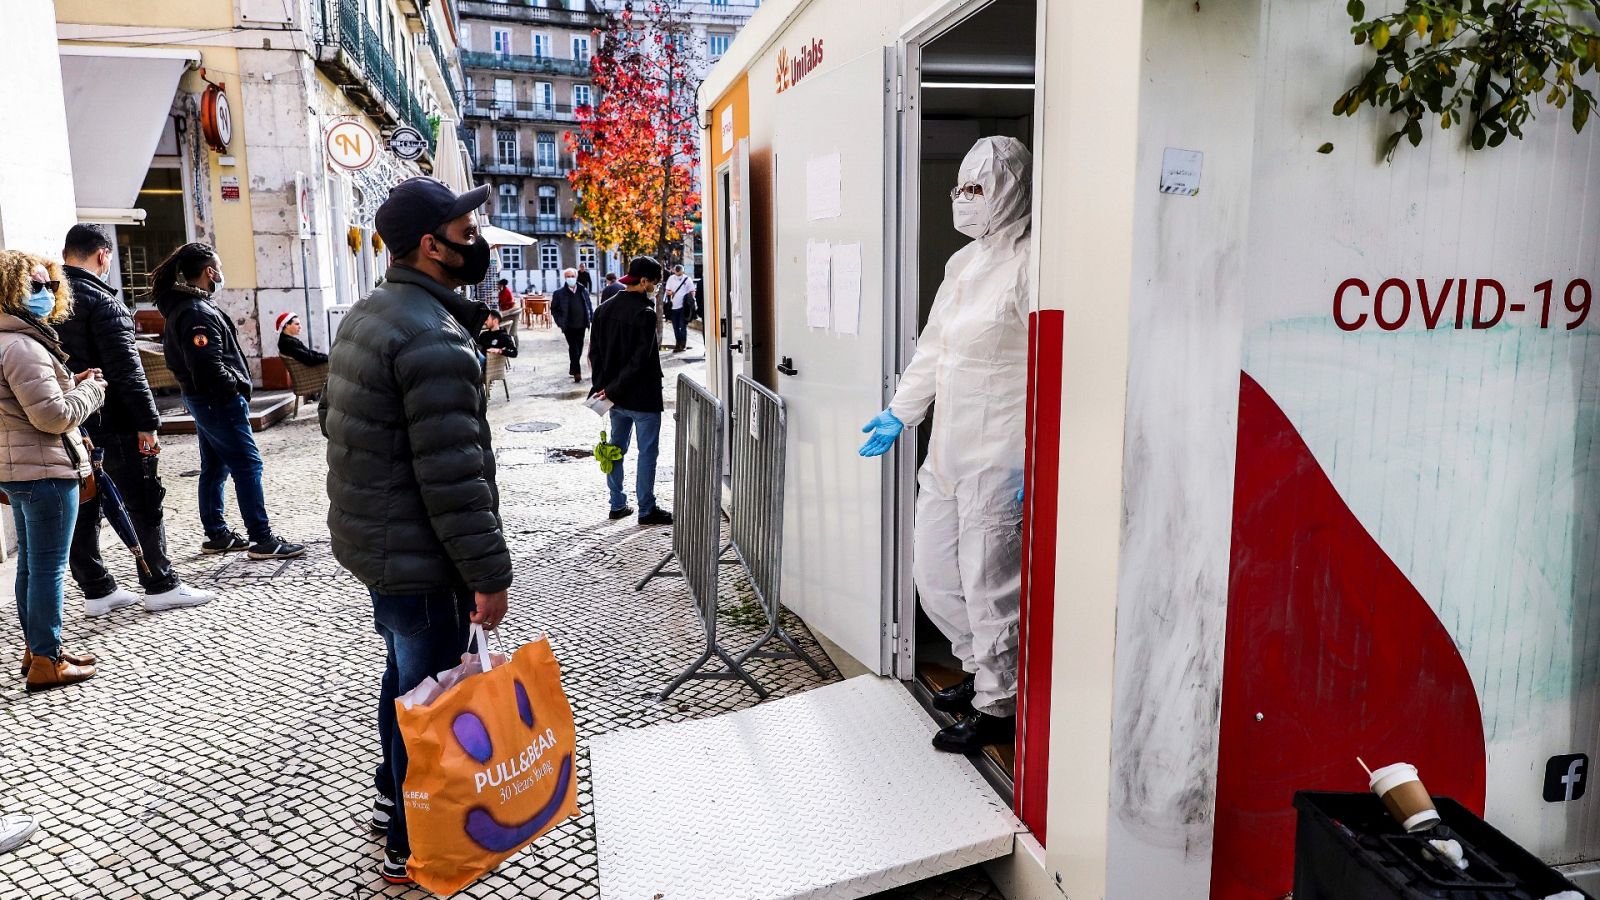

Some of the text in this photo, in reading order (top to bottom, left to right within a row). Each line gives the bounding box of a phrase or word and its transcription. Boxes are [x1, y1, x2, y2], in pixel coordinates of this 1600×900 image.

[790, 37, 824, 86] Unilabs
[334, 133, 361, 157] N
[1332, 277, 1593, 331] COVID-19
[474, 728, 558, 794] PULL&BEAR
[498, 760, 554, 805] 30 Years Young
